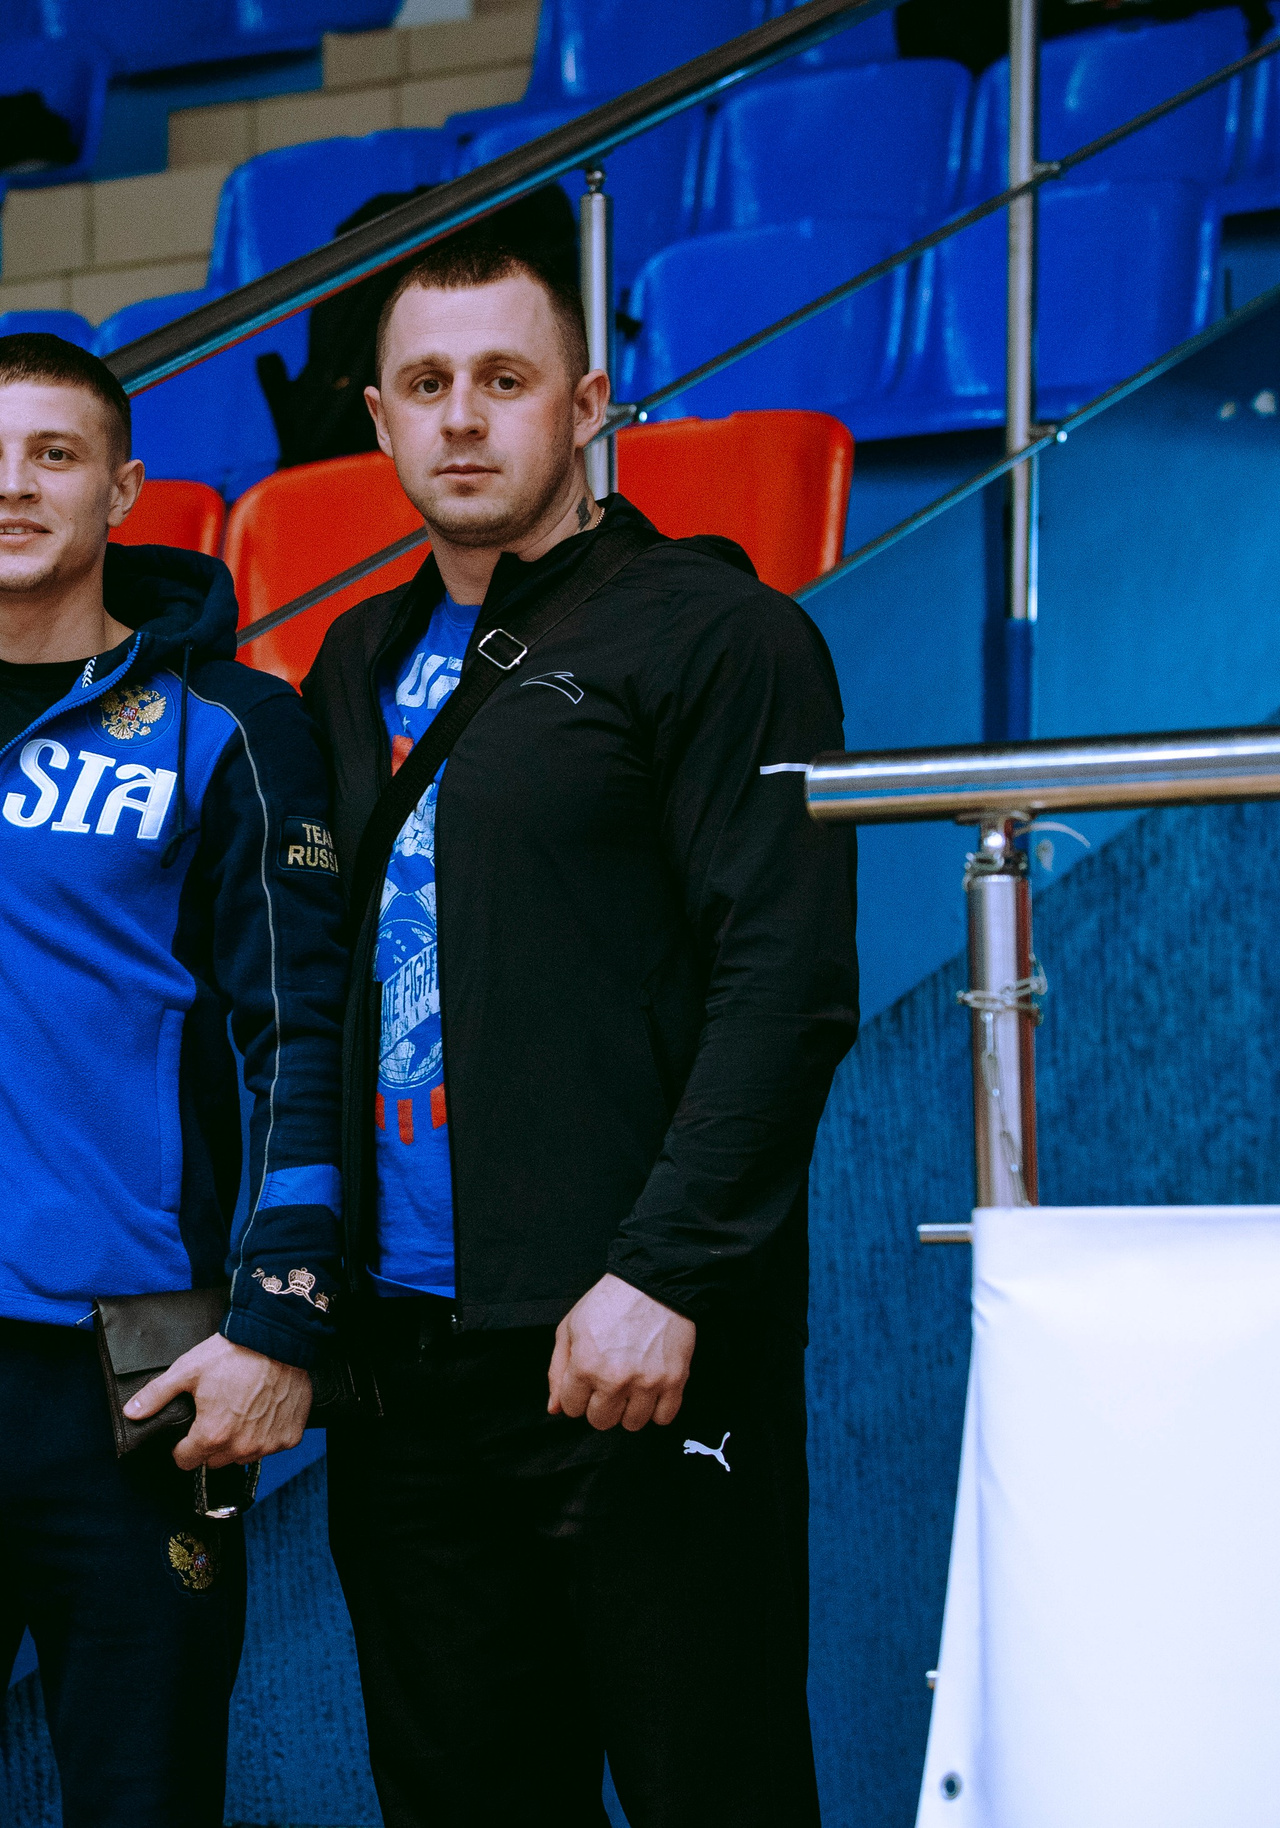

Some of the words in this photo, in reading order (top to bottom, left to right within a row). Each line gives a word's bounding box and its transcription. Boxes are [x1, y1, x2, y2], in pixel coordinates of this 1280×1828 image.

[395, 652, 463, 710] UF
[302, 823, 334, 850] TEA
[287, 845, 339, 874] RUSSI
